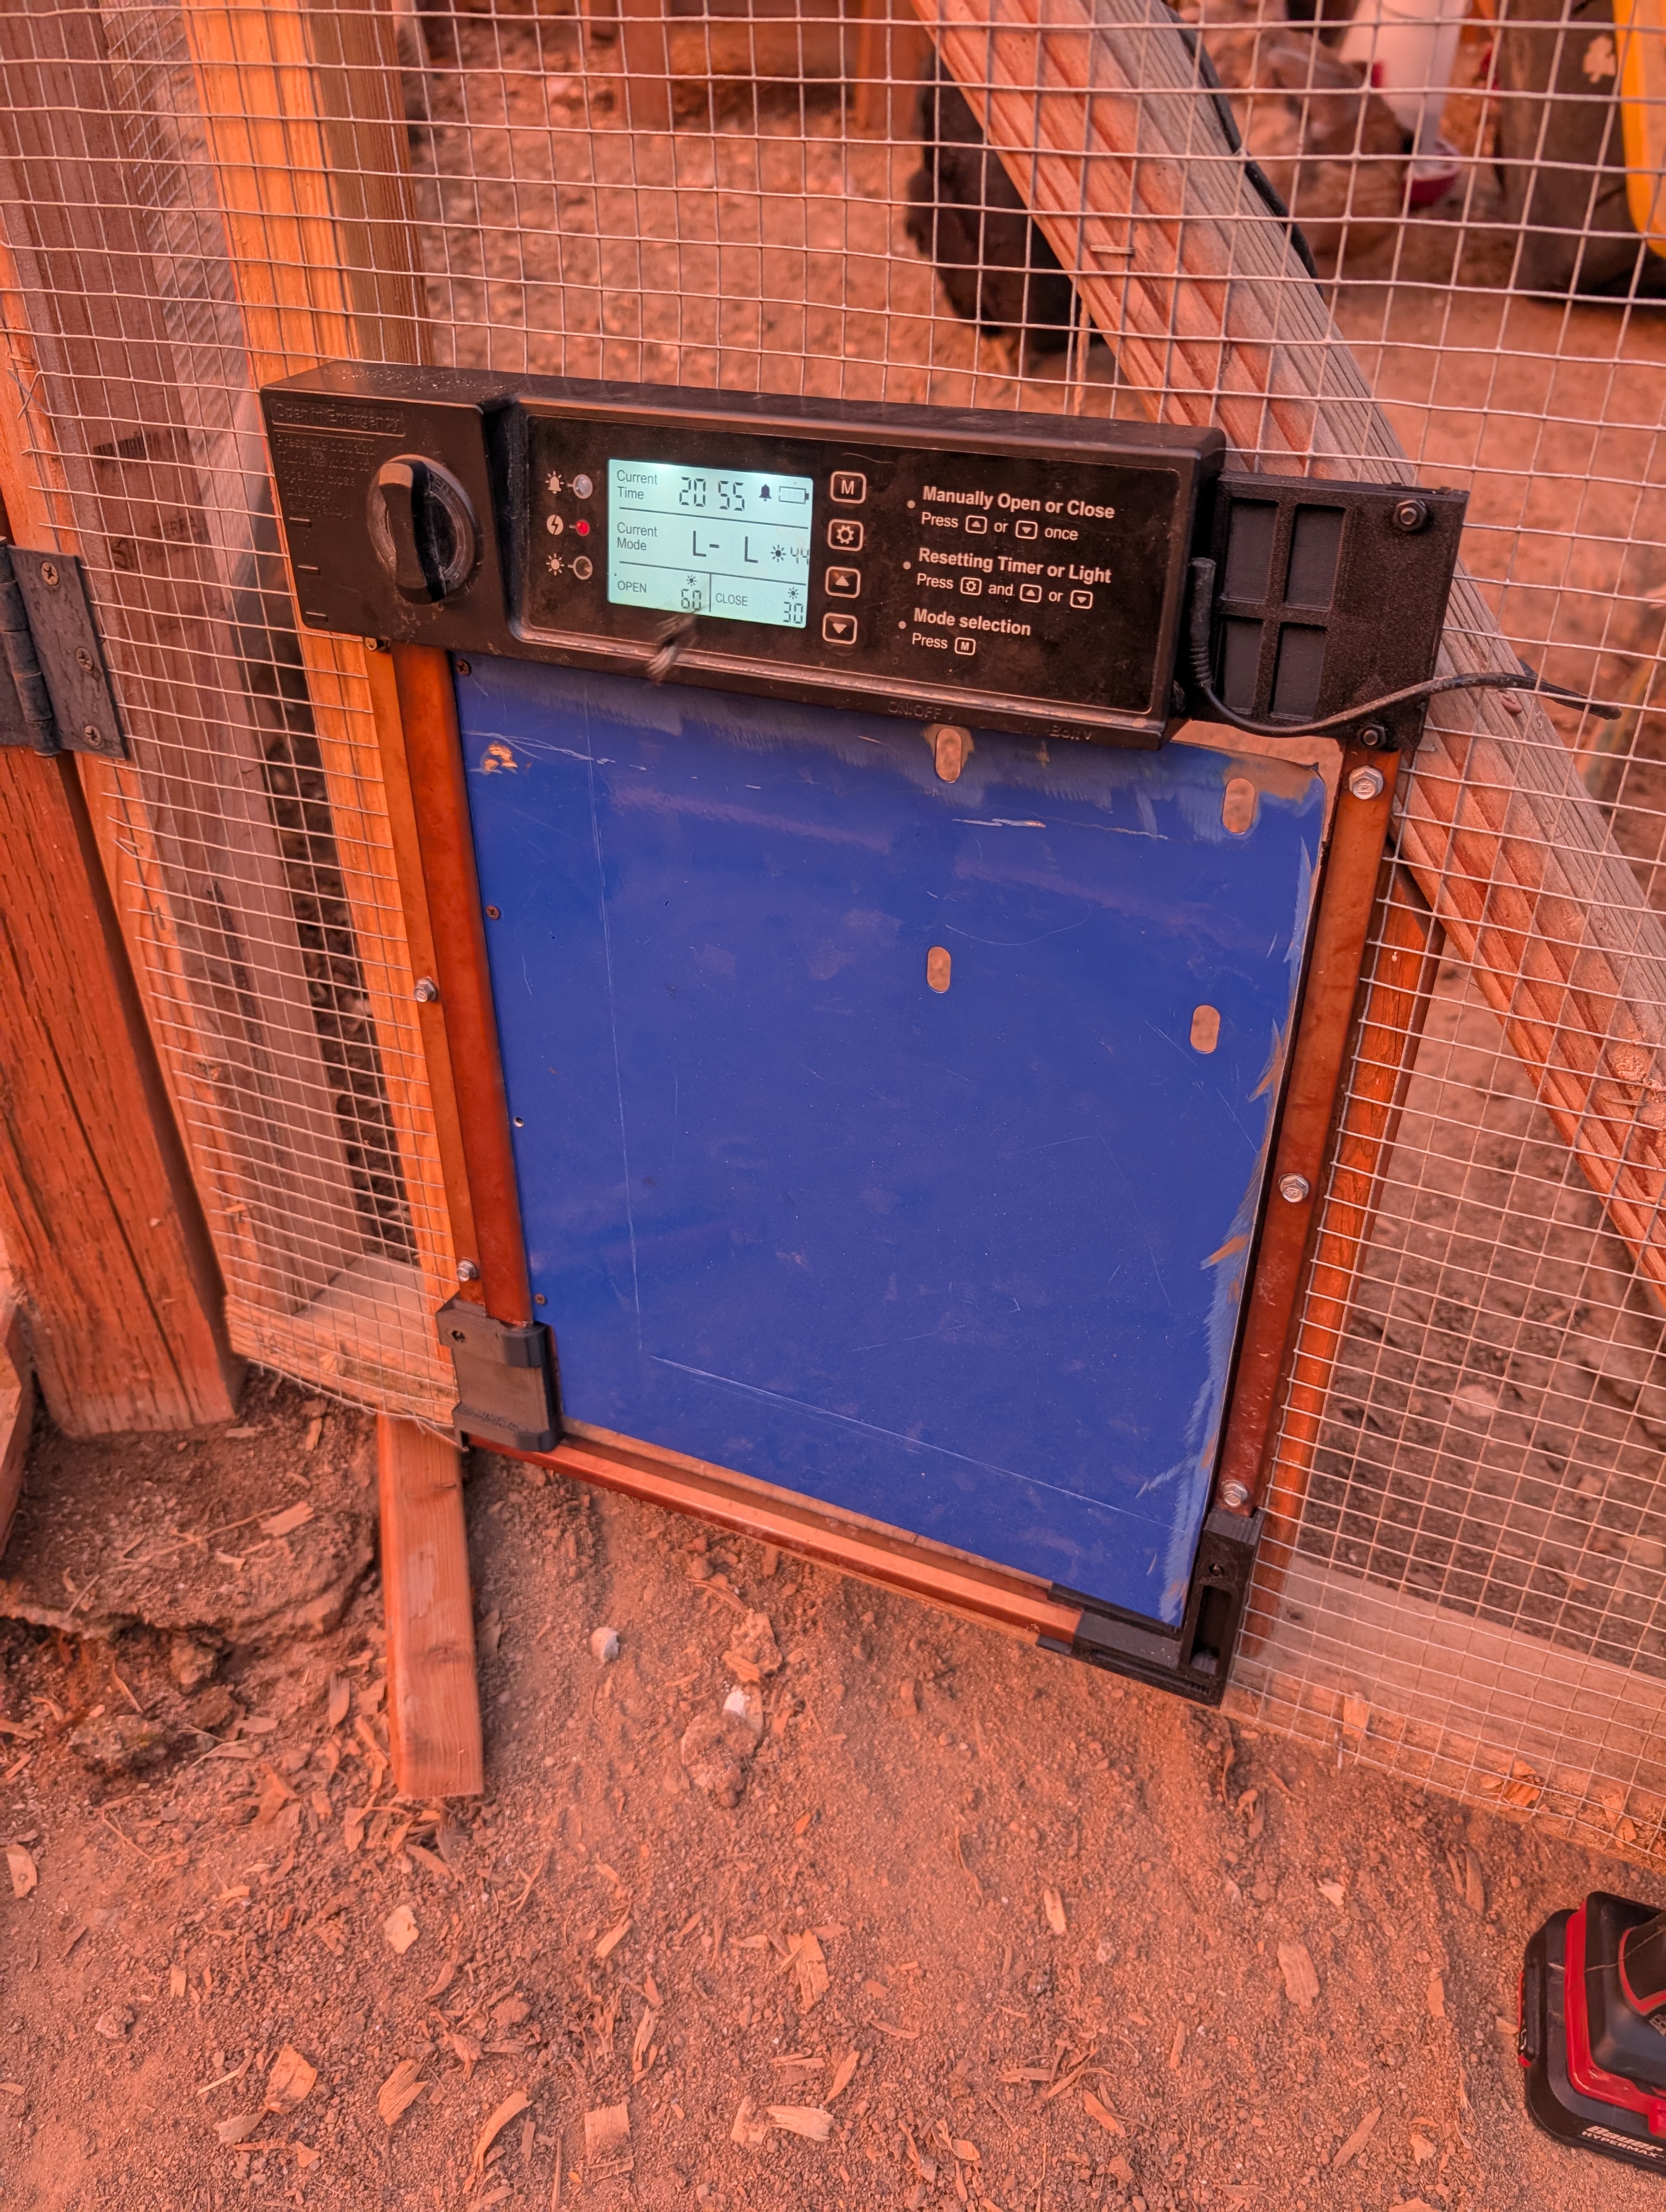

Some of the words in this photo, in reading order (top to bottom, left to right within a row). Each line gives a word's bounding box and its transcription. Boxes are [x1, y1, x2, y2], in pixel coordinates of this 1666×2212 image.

[617, 470, 658, 485] Current
[841, 480, 855, 495] M
[617, 486, 644, 500] Time
[679, 477, 706, 507] 20
[718, 480, 745, 512] 55
[922, 486, 994, 510] Manually
[997, 493, 1040, 512] Open
[1045, 501, 1063, 513] or
[1067, 500, 1115, 519] Close
[617, 522, 658, 537] Current
[921, 511, 959, 528] Press
[994, 522, 1009, 533] or
[1045, 527, 1079, 541] once
[617, 537, 647, 551] Mode
[918, 548, 993, 573] Resetting
[998, 556, 1044, 575] Timer
[1047, 565, 1066, 577] or
[1068, 564, 1112, 584] Light
[618, 581, 647, 593] OPEN
[681, 588, 702, 611] 60
[917, 573, 953, 589] Press
[988, 583, 1013, 596] and
[1048, 591, 1063, 602] or
[715, 593, 748, 607] CLOSE
[783, 601, 804, 625] 30
[914, 608, 955, 626] Mode
[959, 616, 1031, 635] selection
[912, 633, 948, 649] Press
[960, 642, 970, 651] M
[1586, 2125, 1664, 2152] Bauer
